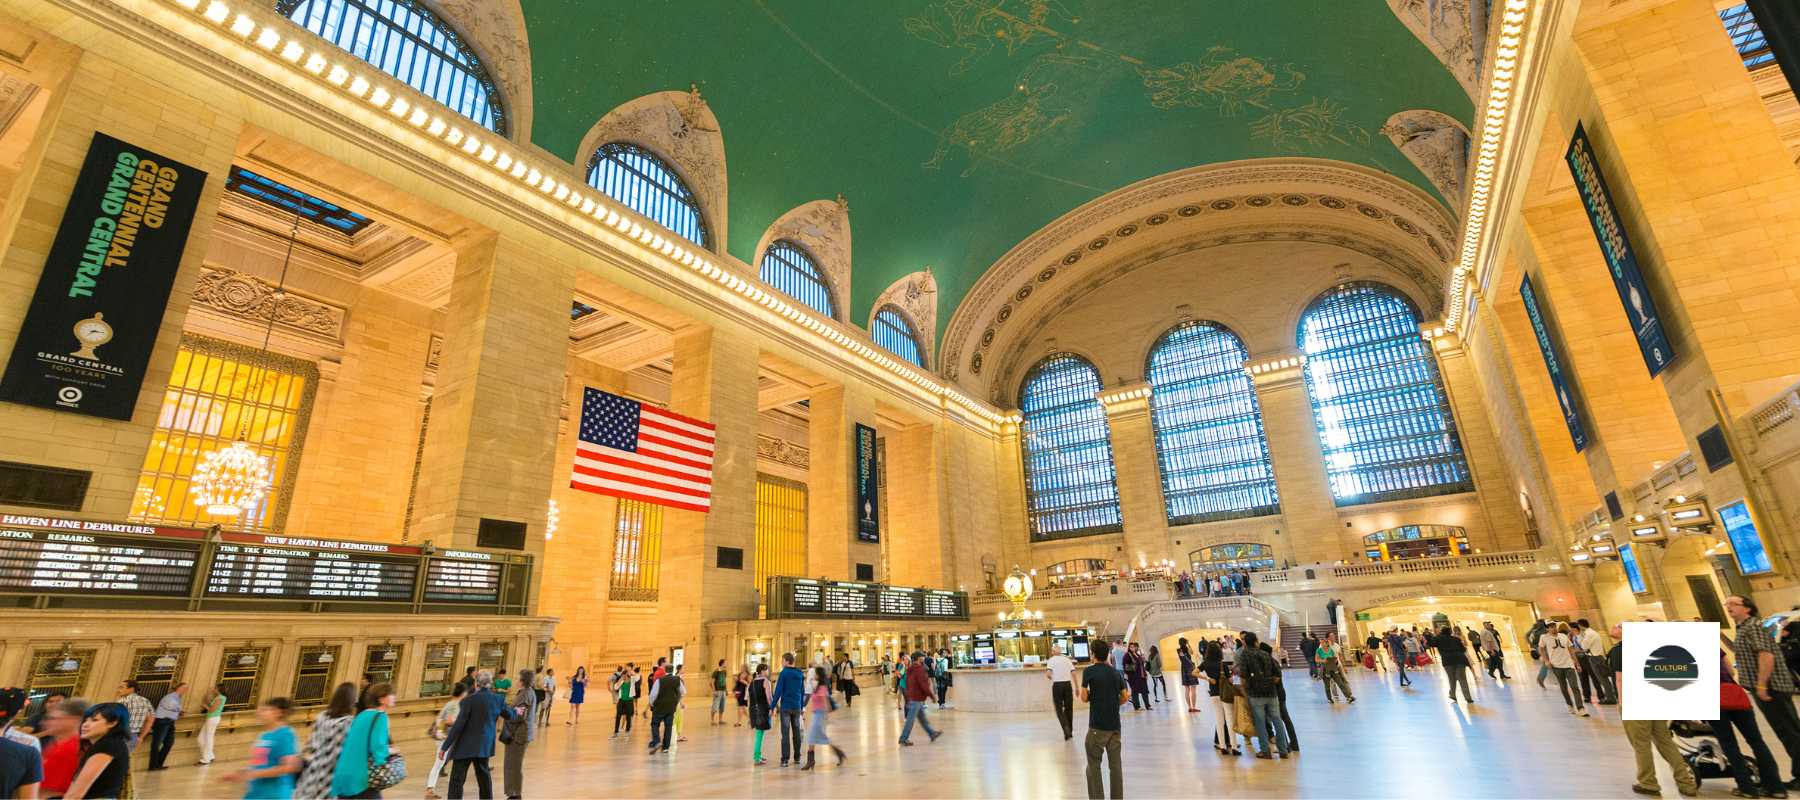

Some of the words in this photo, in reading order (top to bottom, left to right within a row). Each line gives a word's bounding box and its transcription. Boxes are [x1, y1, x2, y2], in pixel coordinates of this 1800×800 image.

[101, 152, 140, 216] GRAND
[143, 167, 178, 229] GRAND
[105, 160, 159, 267] CENTENNIAL
[1596, 215, 1622, 278] GRAND
[68, 217, 117, 298] CENTRAL
[37, 352, 76, 363] GRAND
[78, 361, 124, 373] CENTRAL
[51, 364, 72, 373] 100
[3, 515, 49, 527] HAVEN
[51, 519, 81, 529] LINE
[83, 521, 155, 534] DEPARTURES
[47, 533, 95, 543] REMARKS
[264, 536, 287, 545] NEW
[288, 539, 319, 547] HAVEN
[320, 541, 340, 549] LINE
[341, 542, 388, 552] DEPARTURES
[262, 548, 310, 557] DESTINATION
[445, 550, 491, 560] INFORMATION
